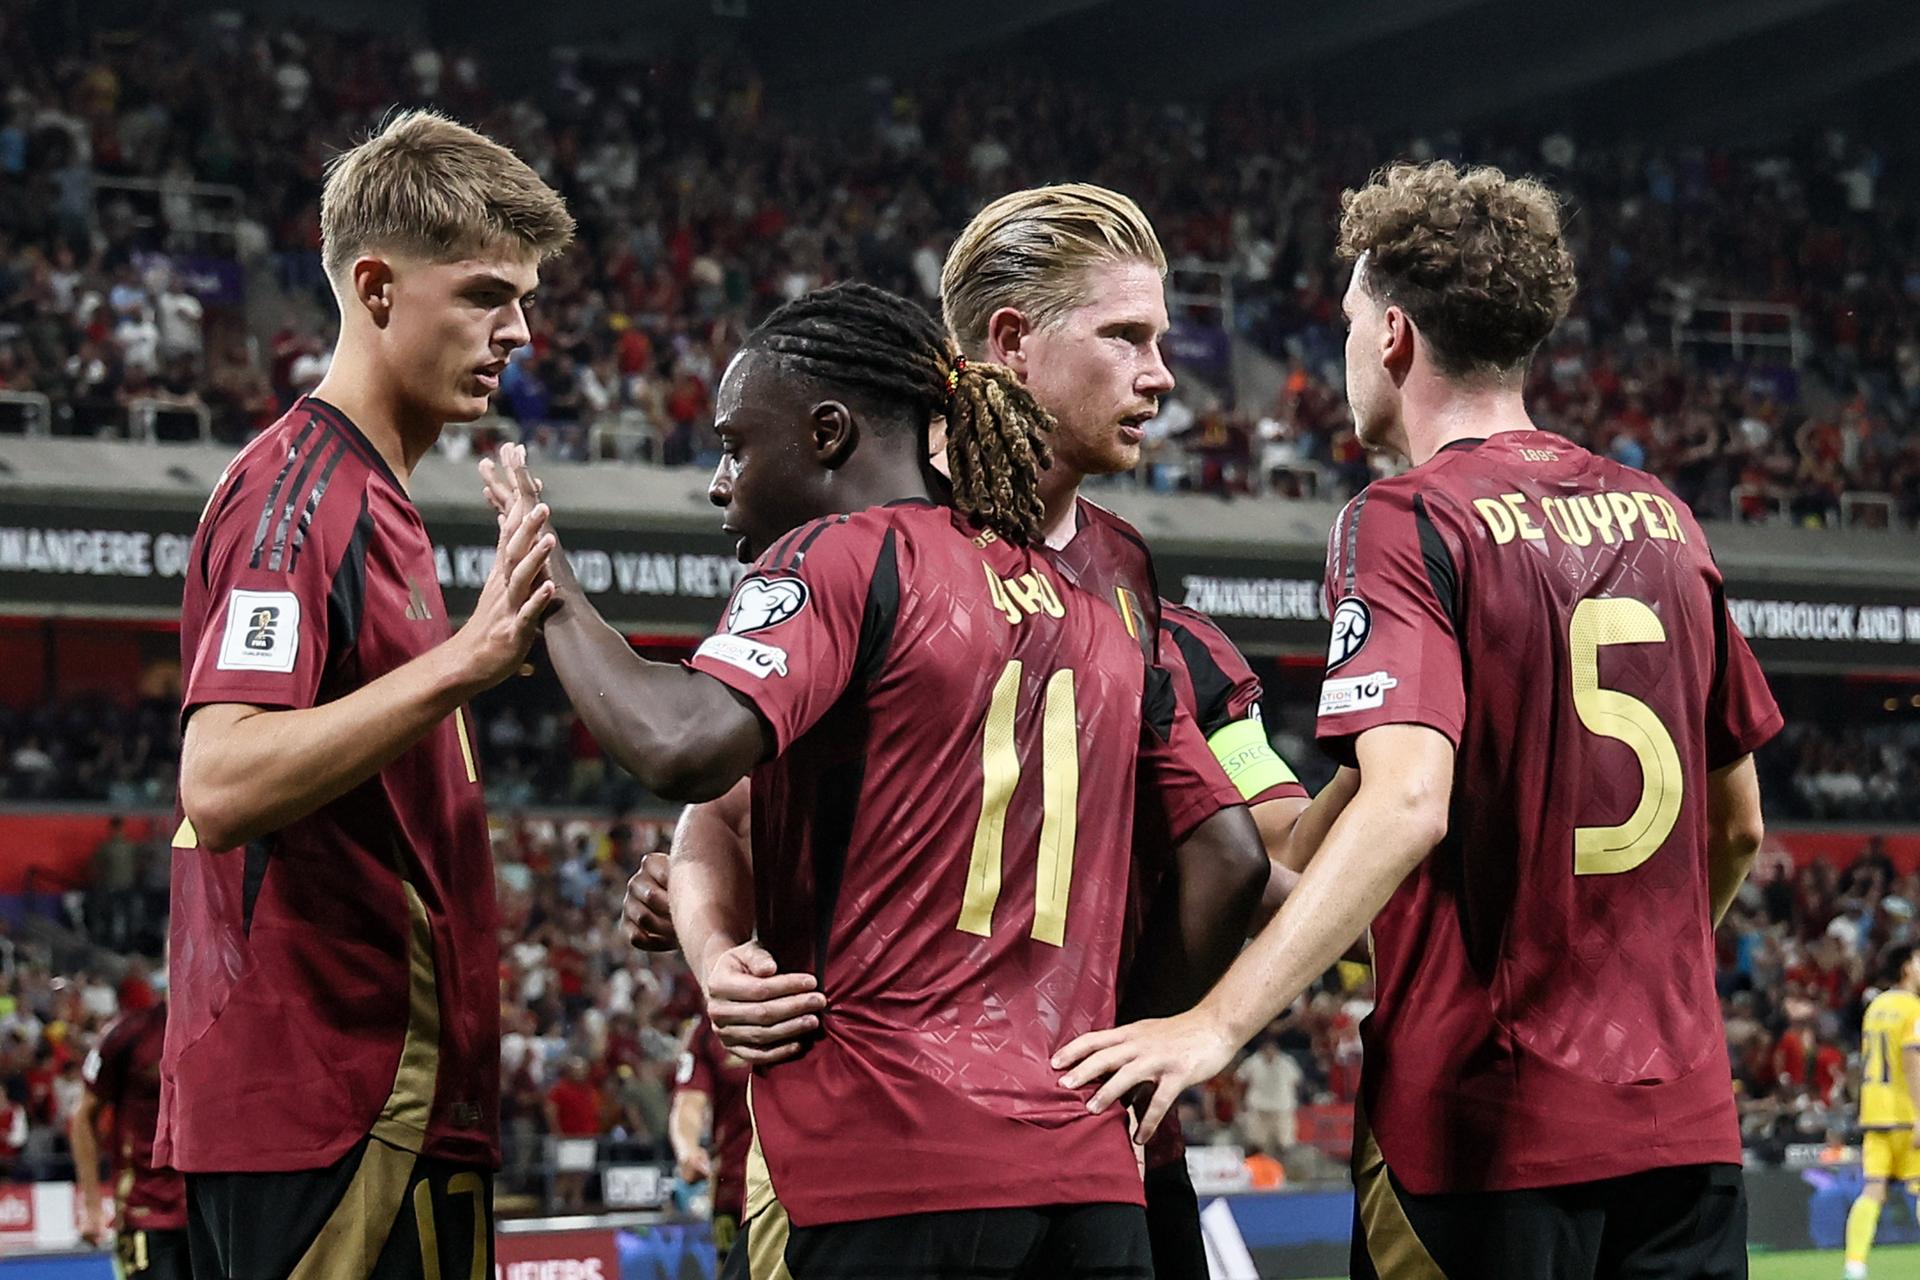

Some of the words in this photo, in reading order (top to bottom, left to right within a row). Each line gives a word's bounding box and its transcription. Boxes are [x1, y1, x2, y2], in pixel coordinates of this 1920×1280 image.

[1518, 448, 1559, 462] 1895
[1472, 492, 1545, 545] DE
[1540, 491, 1686, 546] CUYPER
[613, 552, 676, 595] VAN
[1857, 606, 1904, 644] AND
[1569, 597, 1684, 876] 5
[956, 658, 1079, 949] 11
[413, 1171, 487, 1280] 17
